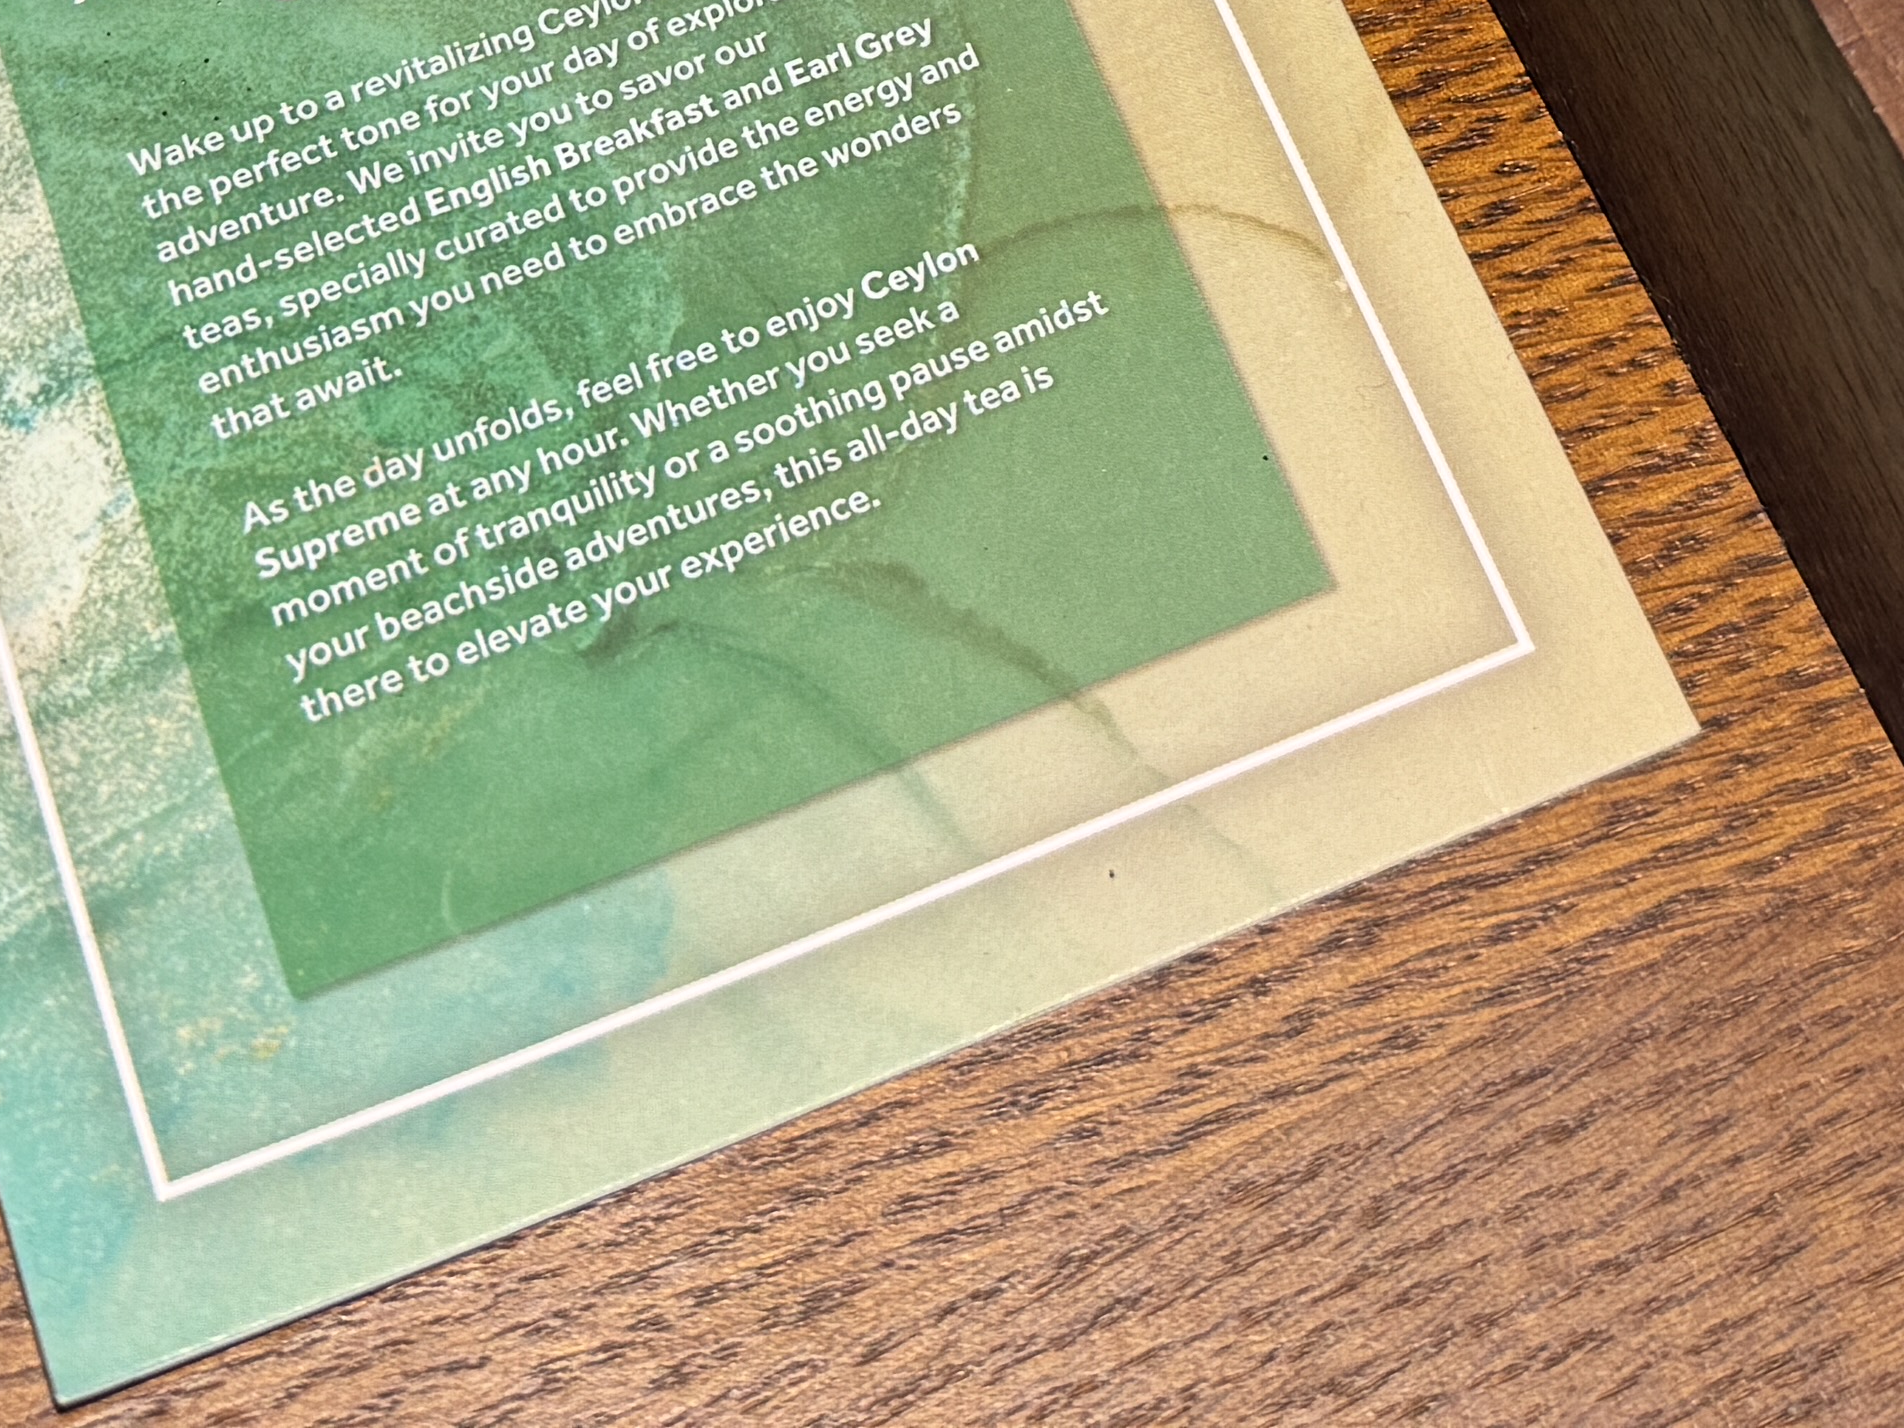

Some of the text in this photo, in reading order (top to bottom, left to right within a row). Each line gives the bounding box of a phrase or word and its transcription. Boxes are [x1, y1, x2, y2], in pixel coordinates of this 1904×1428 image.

[125, 130, 226, 177] Wake
[228, 113, 276, 145] up
[278, 98, 319, 126] to
[323, 89, 346, 112] a
[349, 23, 536, 104] revitalizing
[209, 355, 404, 441] that await.
[242, 242, 981, 536] As the day unfolds, feel free to enjoy Ceylon
